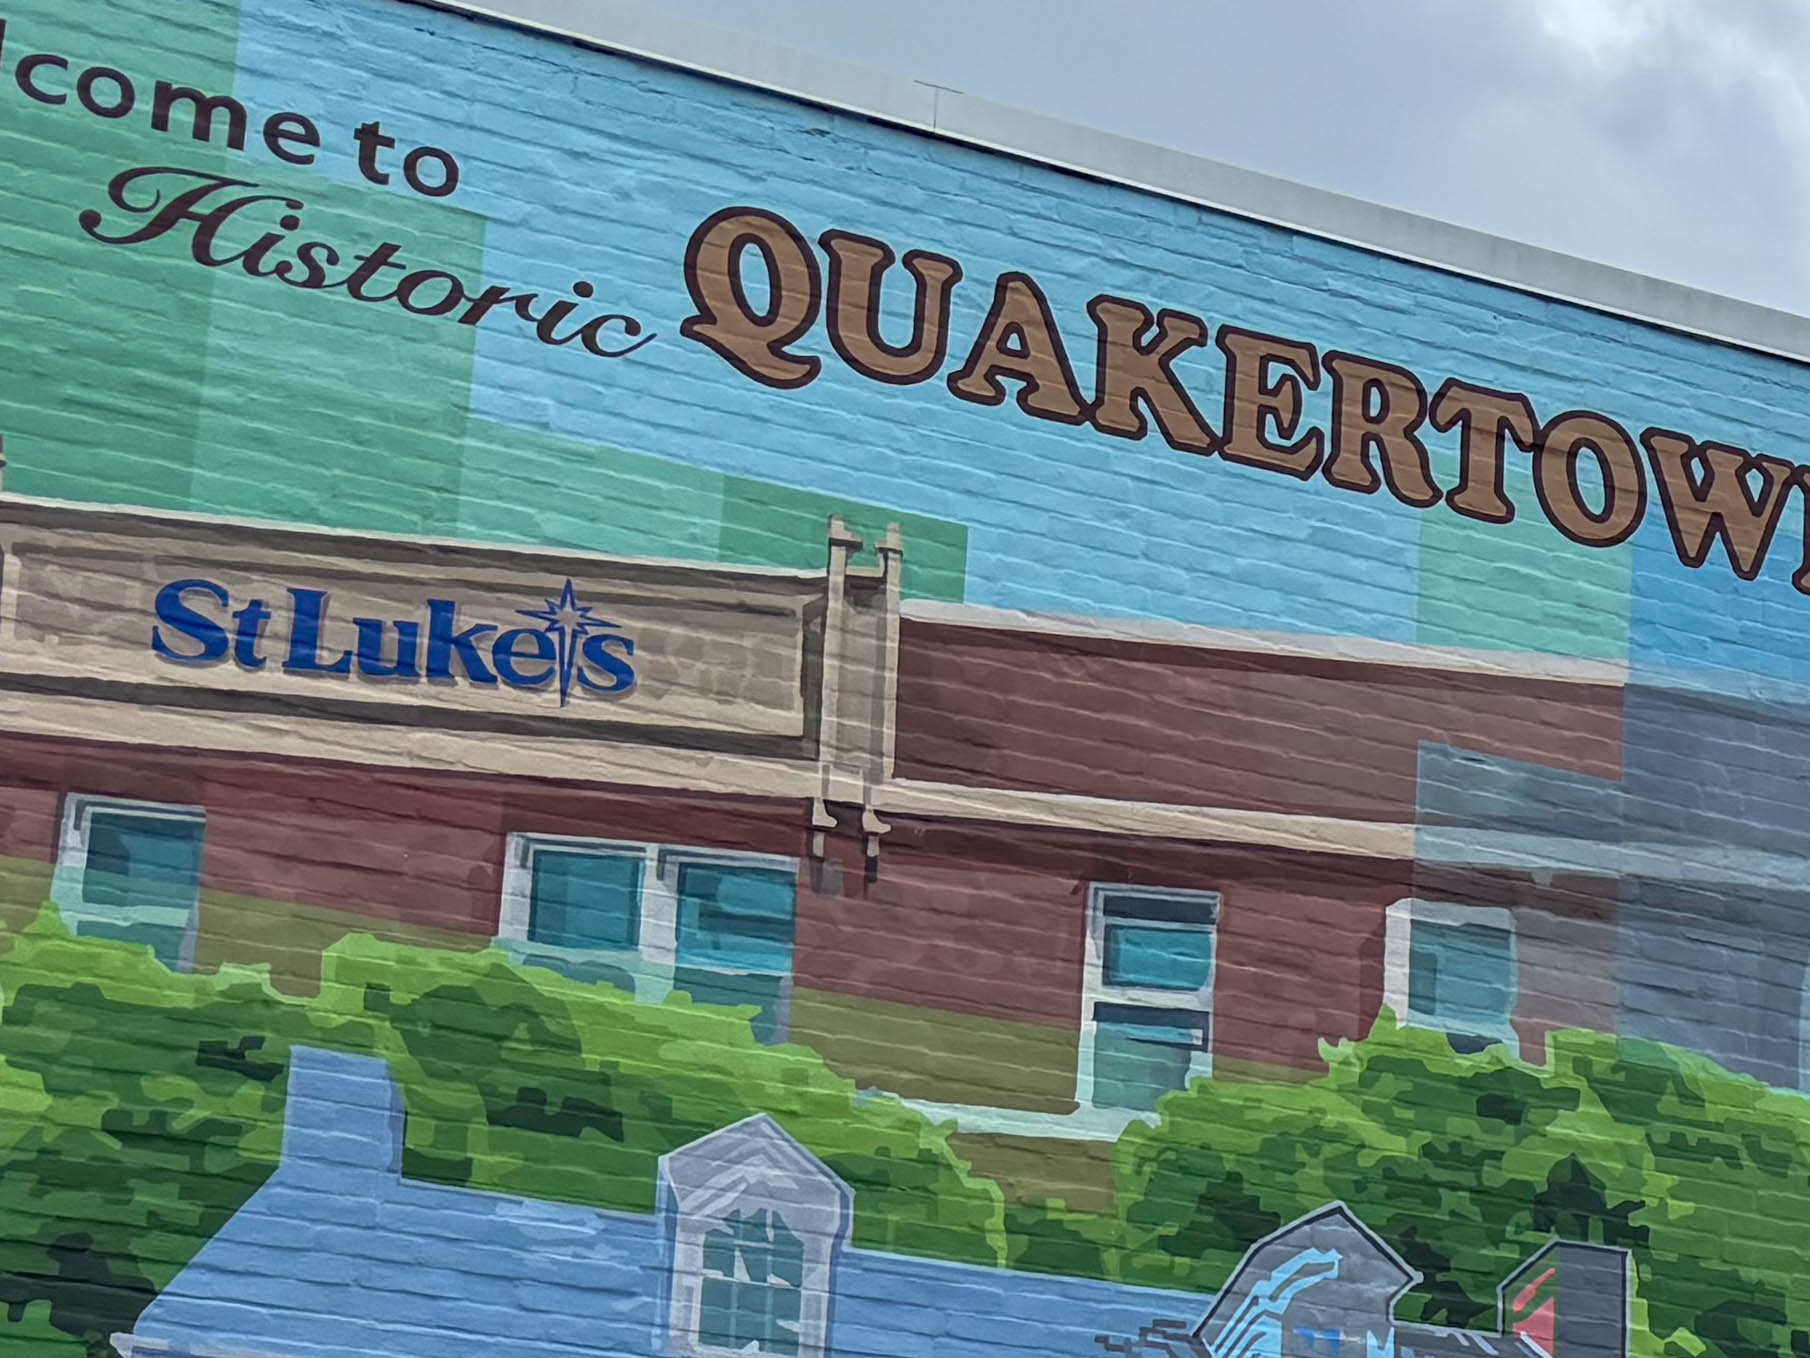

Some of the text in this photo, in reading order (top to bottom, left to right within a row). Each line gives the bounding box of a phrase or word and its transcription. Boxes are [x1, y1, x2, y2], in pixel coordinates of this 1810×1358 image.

[0, 18, 460, 198] come to
[79, 166, 656, 359] Historic
